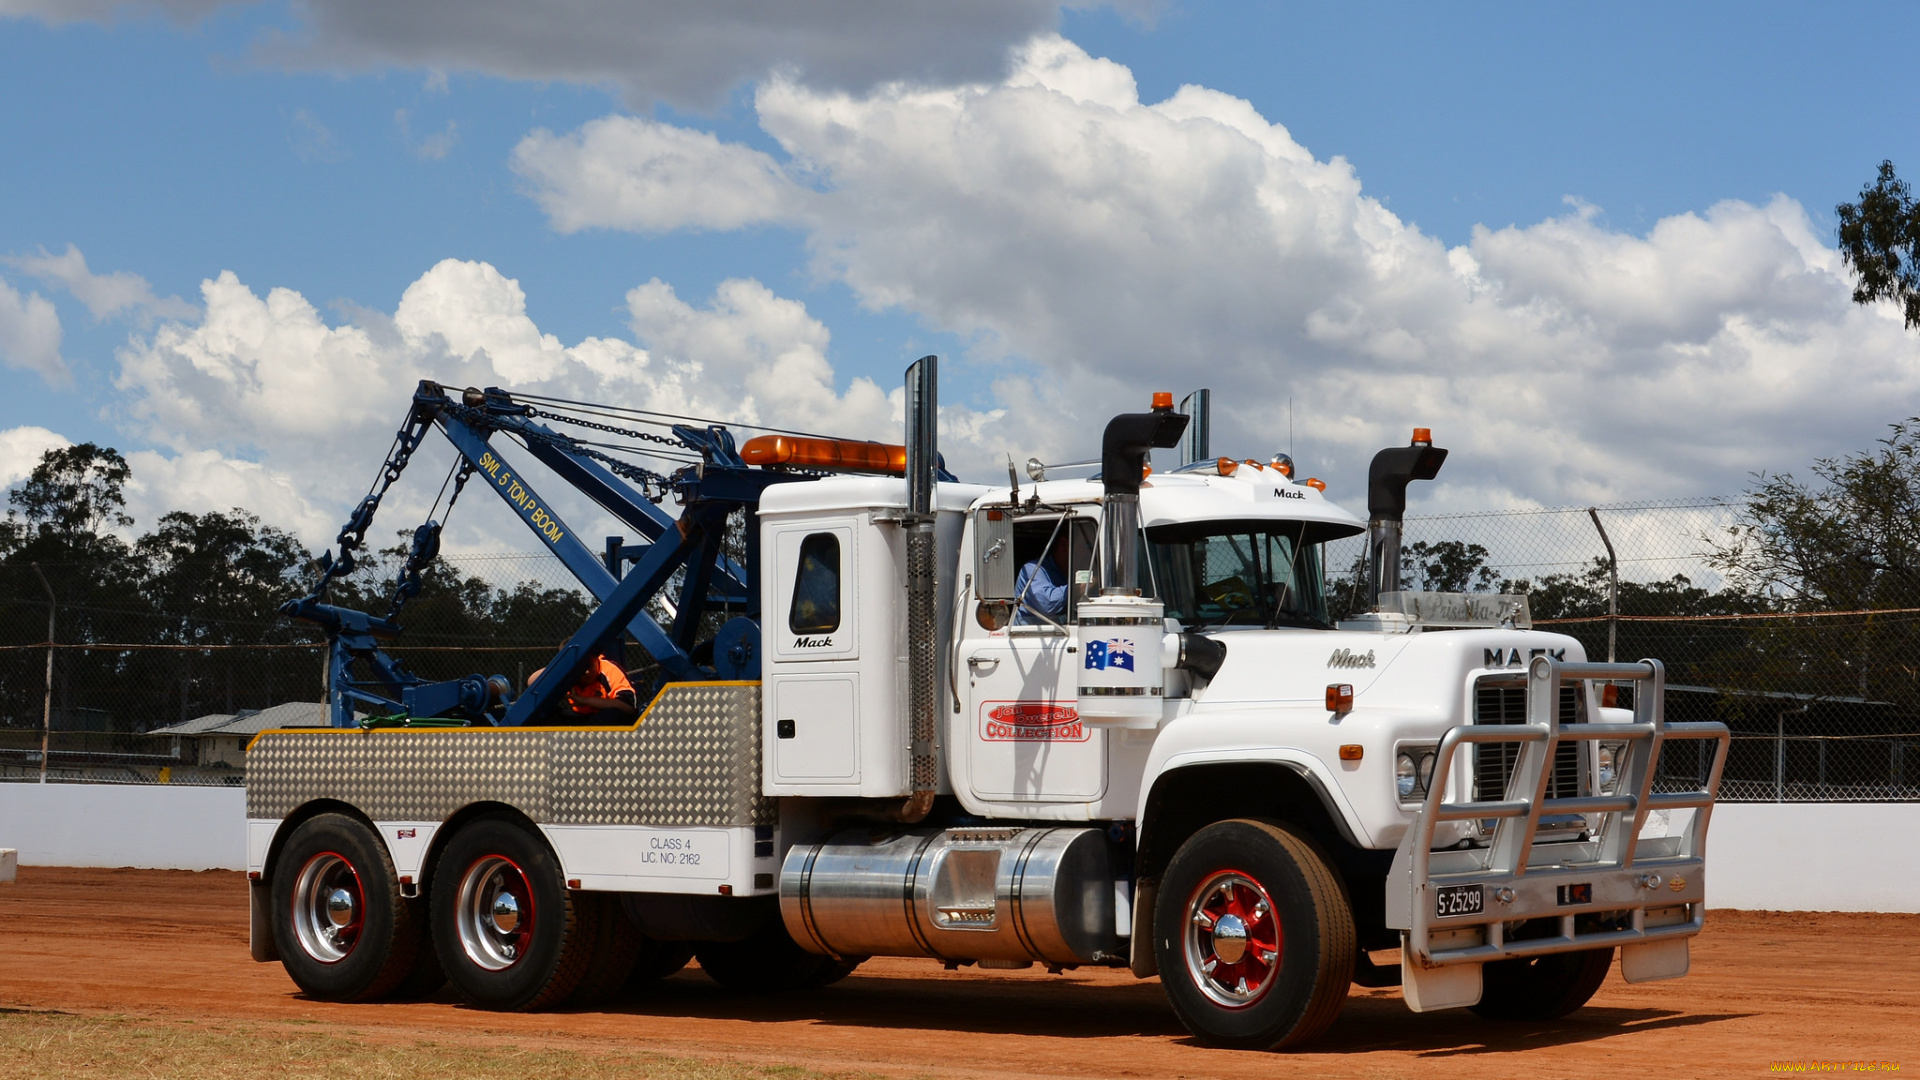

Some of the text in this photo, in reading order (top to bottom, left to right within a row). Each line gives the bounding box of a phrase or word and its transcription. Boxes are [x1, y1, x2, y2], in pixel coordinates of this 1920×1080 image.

[479, 452, 564, 544] SWL 5 TON P BOOM
[1273, 488, 1306, 500] Mack
[793, 636, 833, 649] Mack
[1327, 648, 1376, 669] Mack
[986, 721, 1083, 739] COLLECTION
[650, 837, 691, 850] CLASS 4
[641, 852, 700, 865] LIC. NO: 2162
